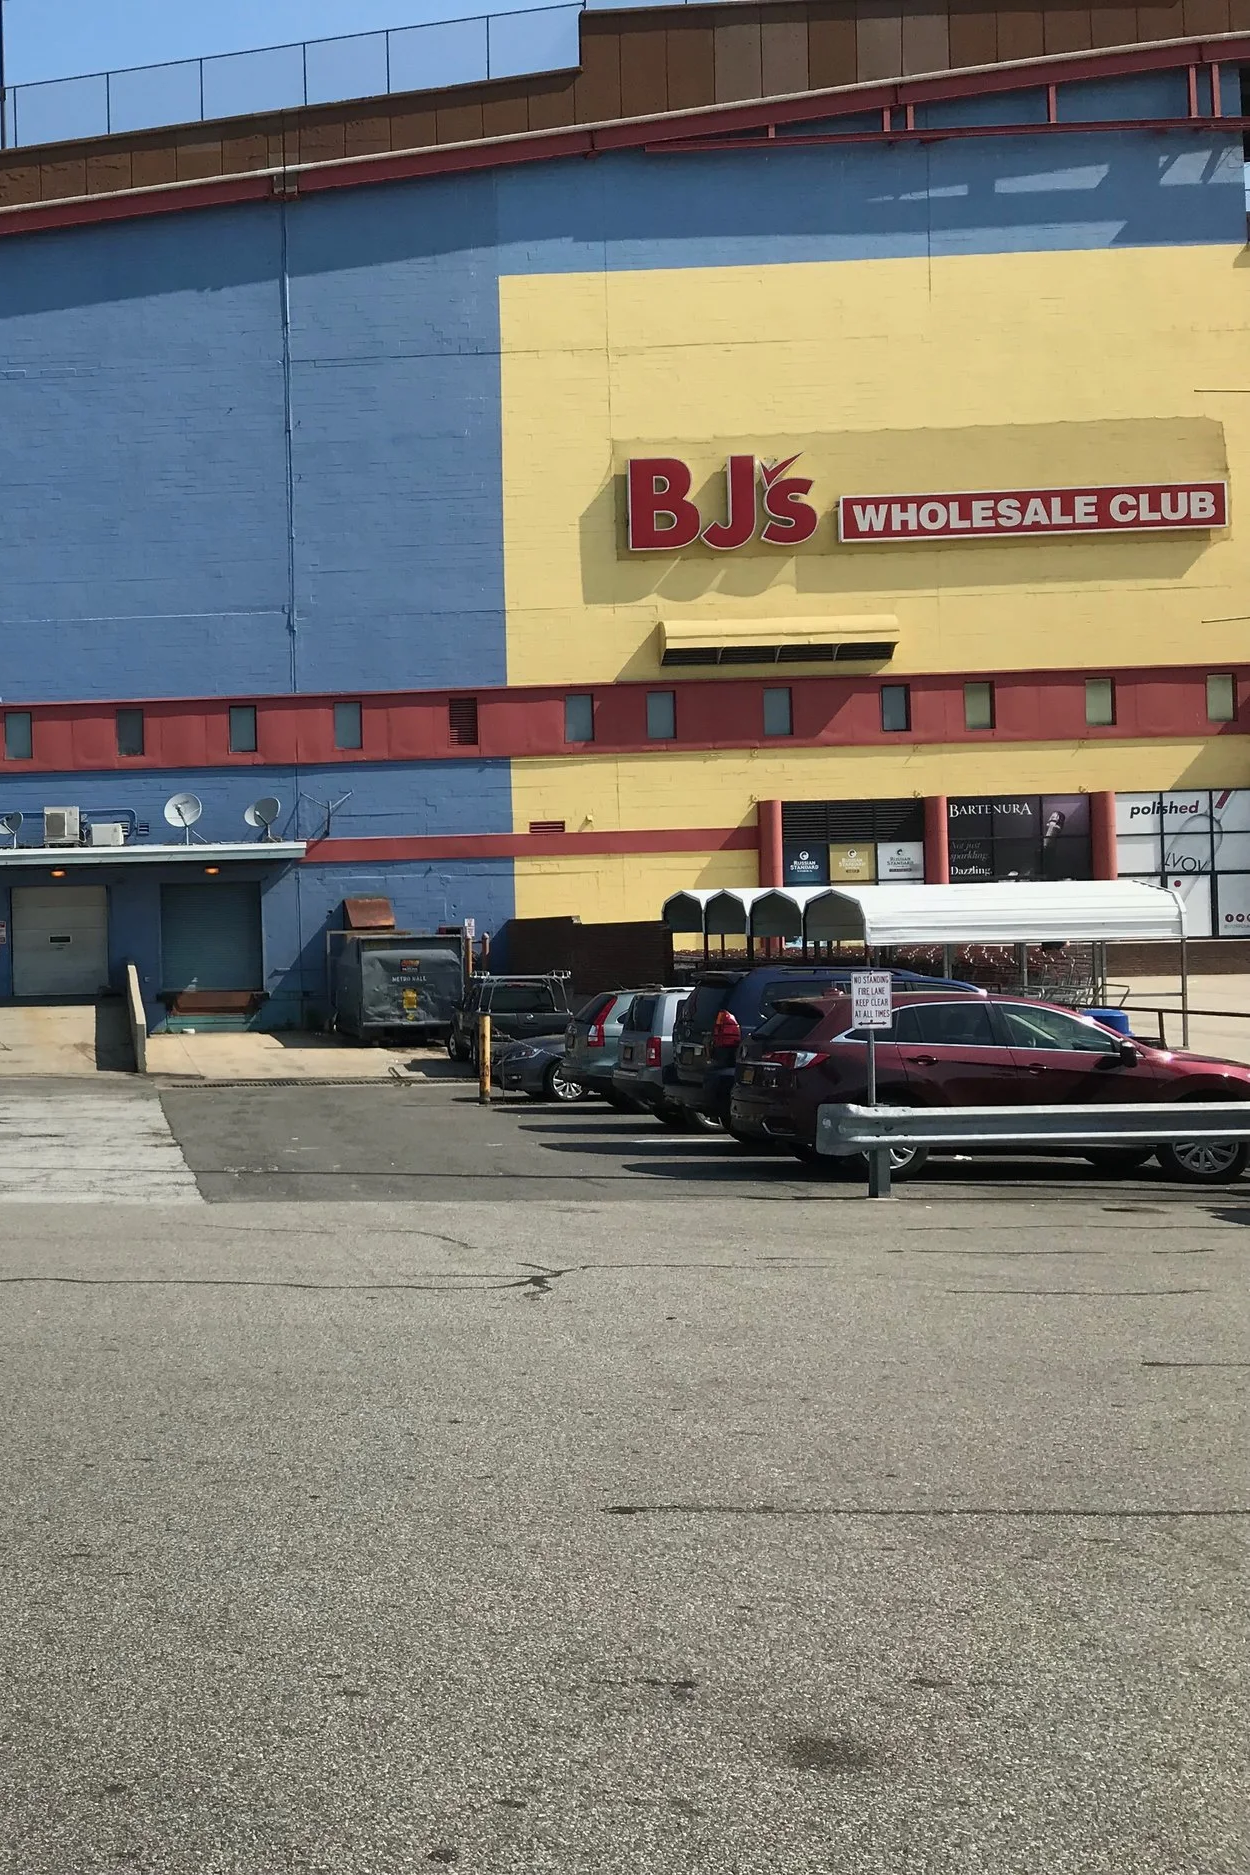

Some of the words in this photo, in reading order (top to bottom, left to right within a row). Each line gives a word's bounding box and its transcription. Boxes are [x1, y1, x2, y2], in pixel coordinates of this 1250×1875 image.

[627, 451, 819, 551] BJ's
[852, 495, 1098, 532] WHOLESALE
[1109, 491, 1217, 523] CLUB
[950, 803, 1032, 818] BARTENURA
[1130, 800, 1199, 818] polished
[951, 841, 964, 849] Not
[965, 841, 981, 850] just
[950, 866, 992, 876] Dazzling.
[854, 976, 861, 984] NO
[863, 976, 888, 984] STANDING
[858, 987, 870, 995] FIRE
[871, 987, 885, 995] LANE
[855, 1010, 861, 1018] AT
[863, 1010, 873, 1018] ALL
